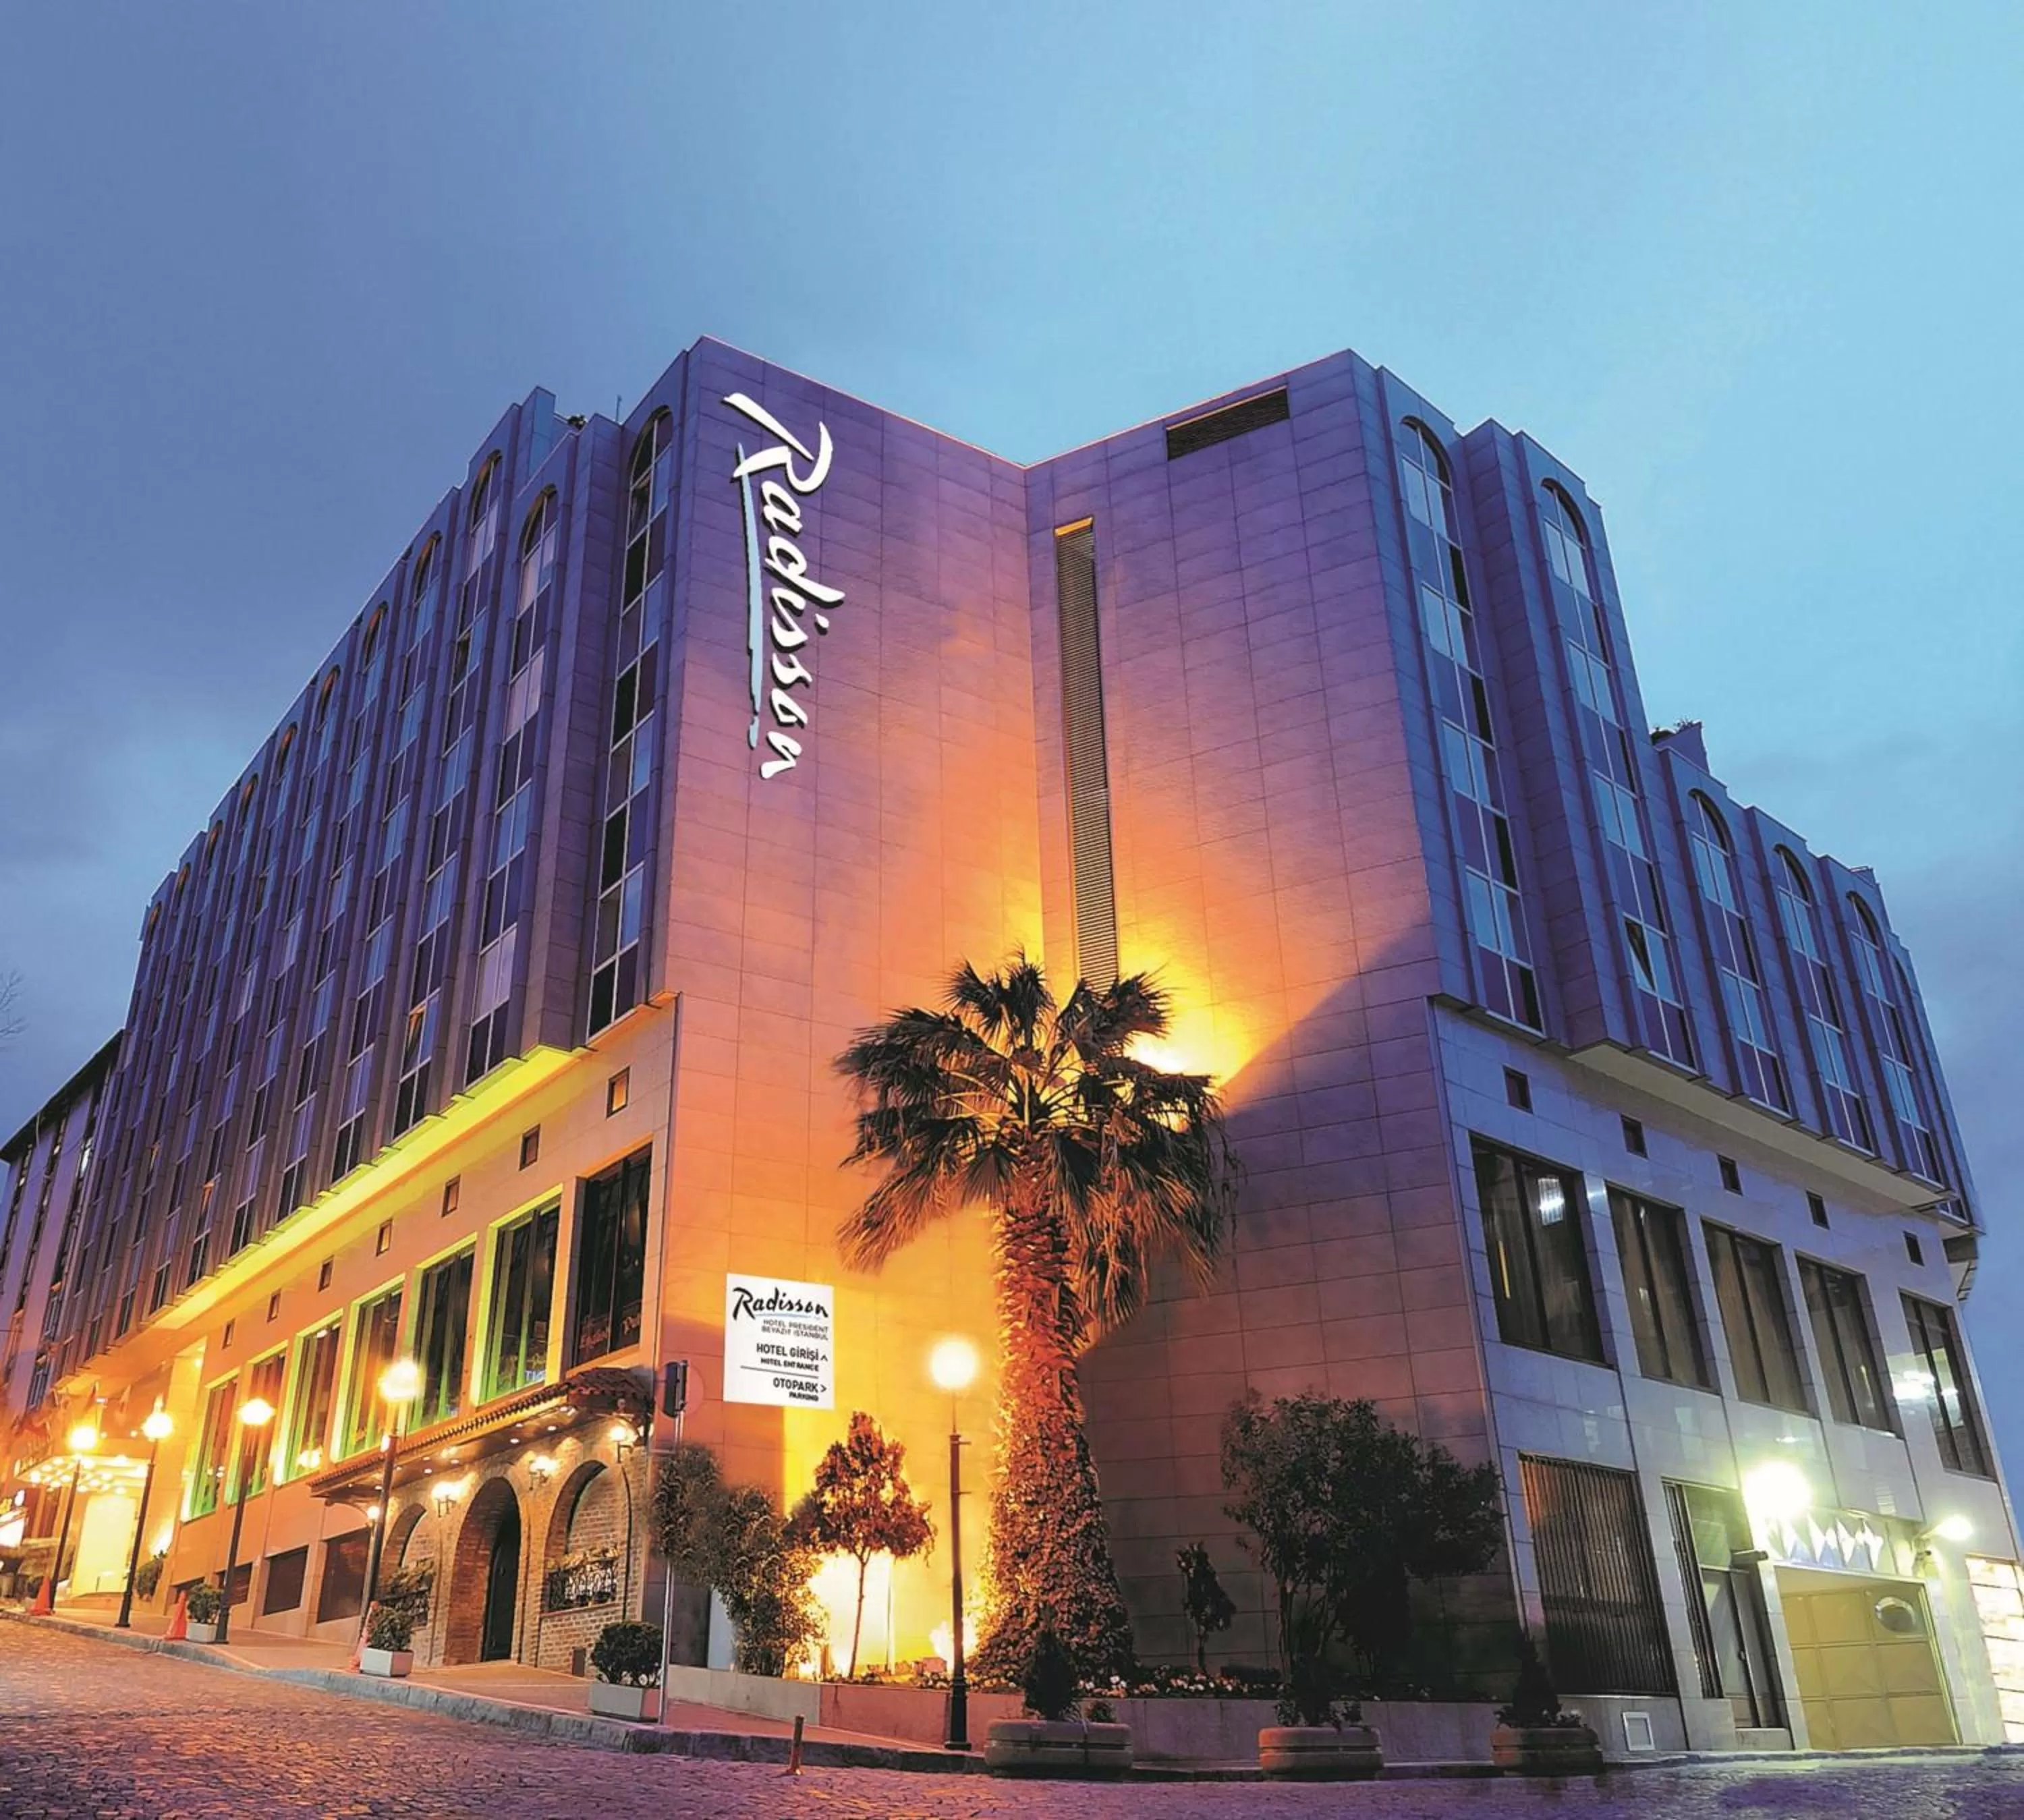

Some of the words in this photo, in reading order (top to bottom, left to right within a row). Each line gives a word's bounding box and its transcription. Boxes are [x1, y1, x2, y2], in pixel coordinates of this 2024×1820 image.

[723, 392, 845, 780] Radisson
[732, 1286, 829, 1321] Radisson
[763, 1319, 785, 1328] HOTEL
[788, 1321, 828, 1333] PRESIDENT
[756, 1343, 787, 1357] HOTEL
[789, 1346, 818, 1362] GİRİŞİ
[760, 1357, 782, 1367] HOTEL
[783, 1360, 819, 1372] ENTRANCE
[772, 1377, 819, 1393] OTOPARK
